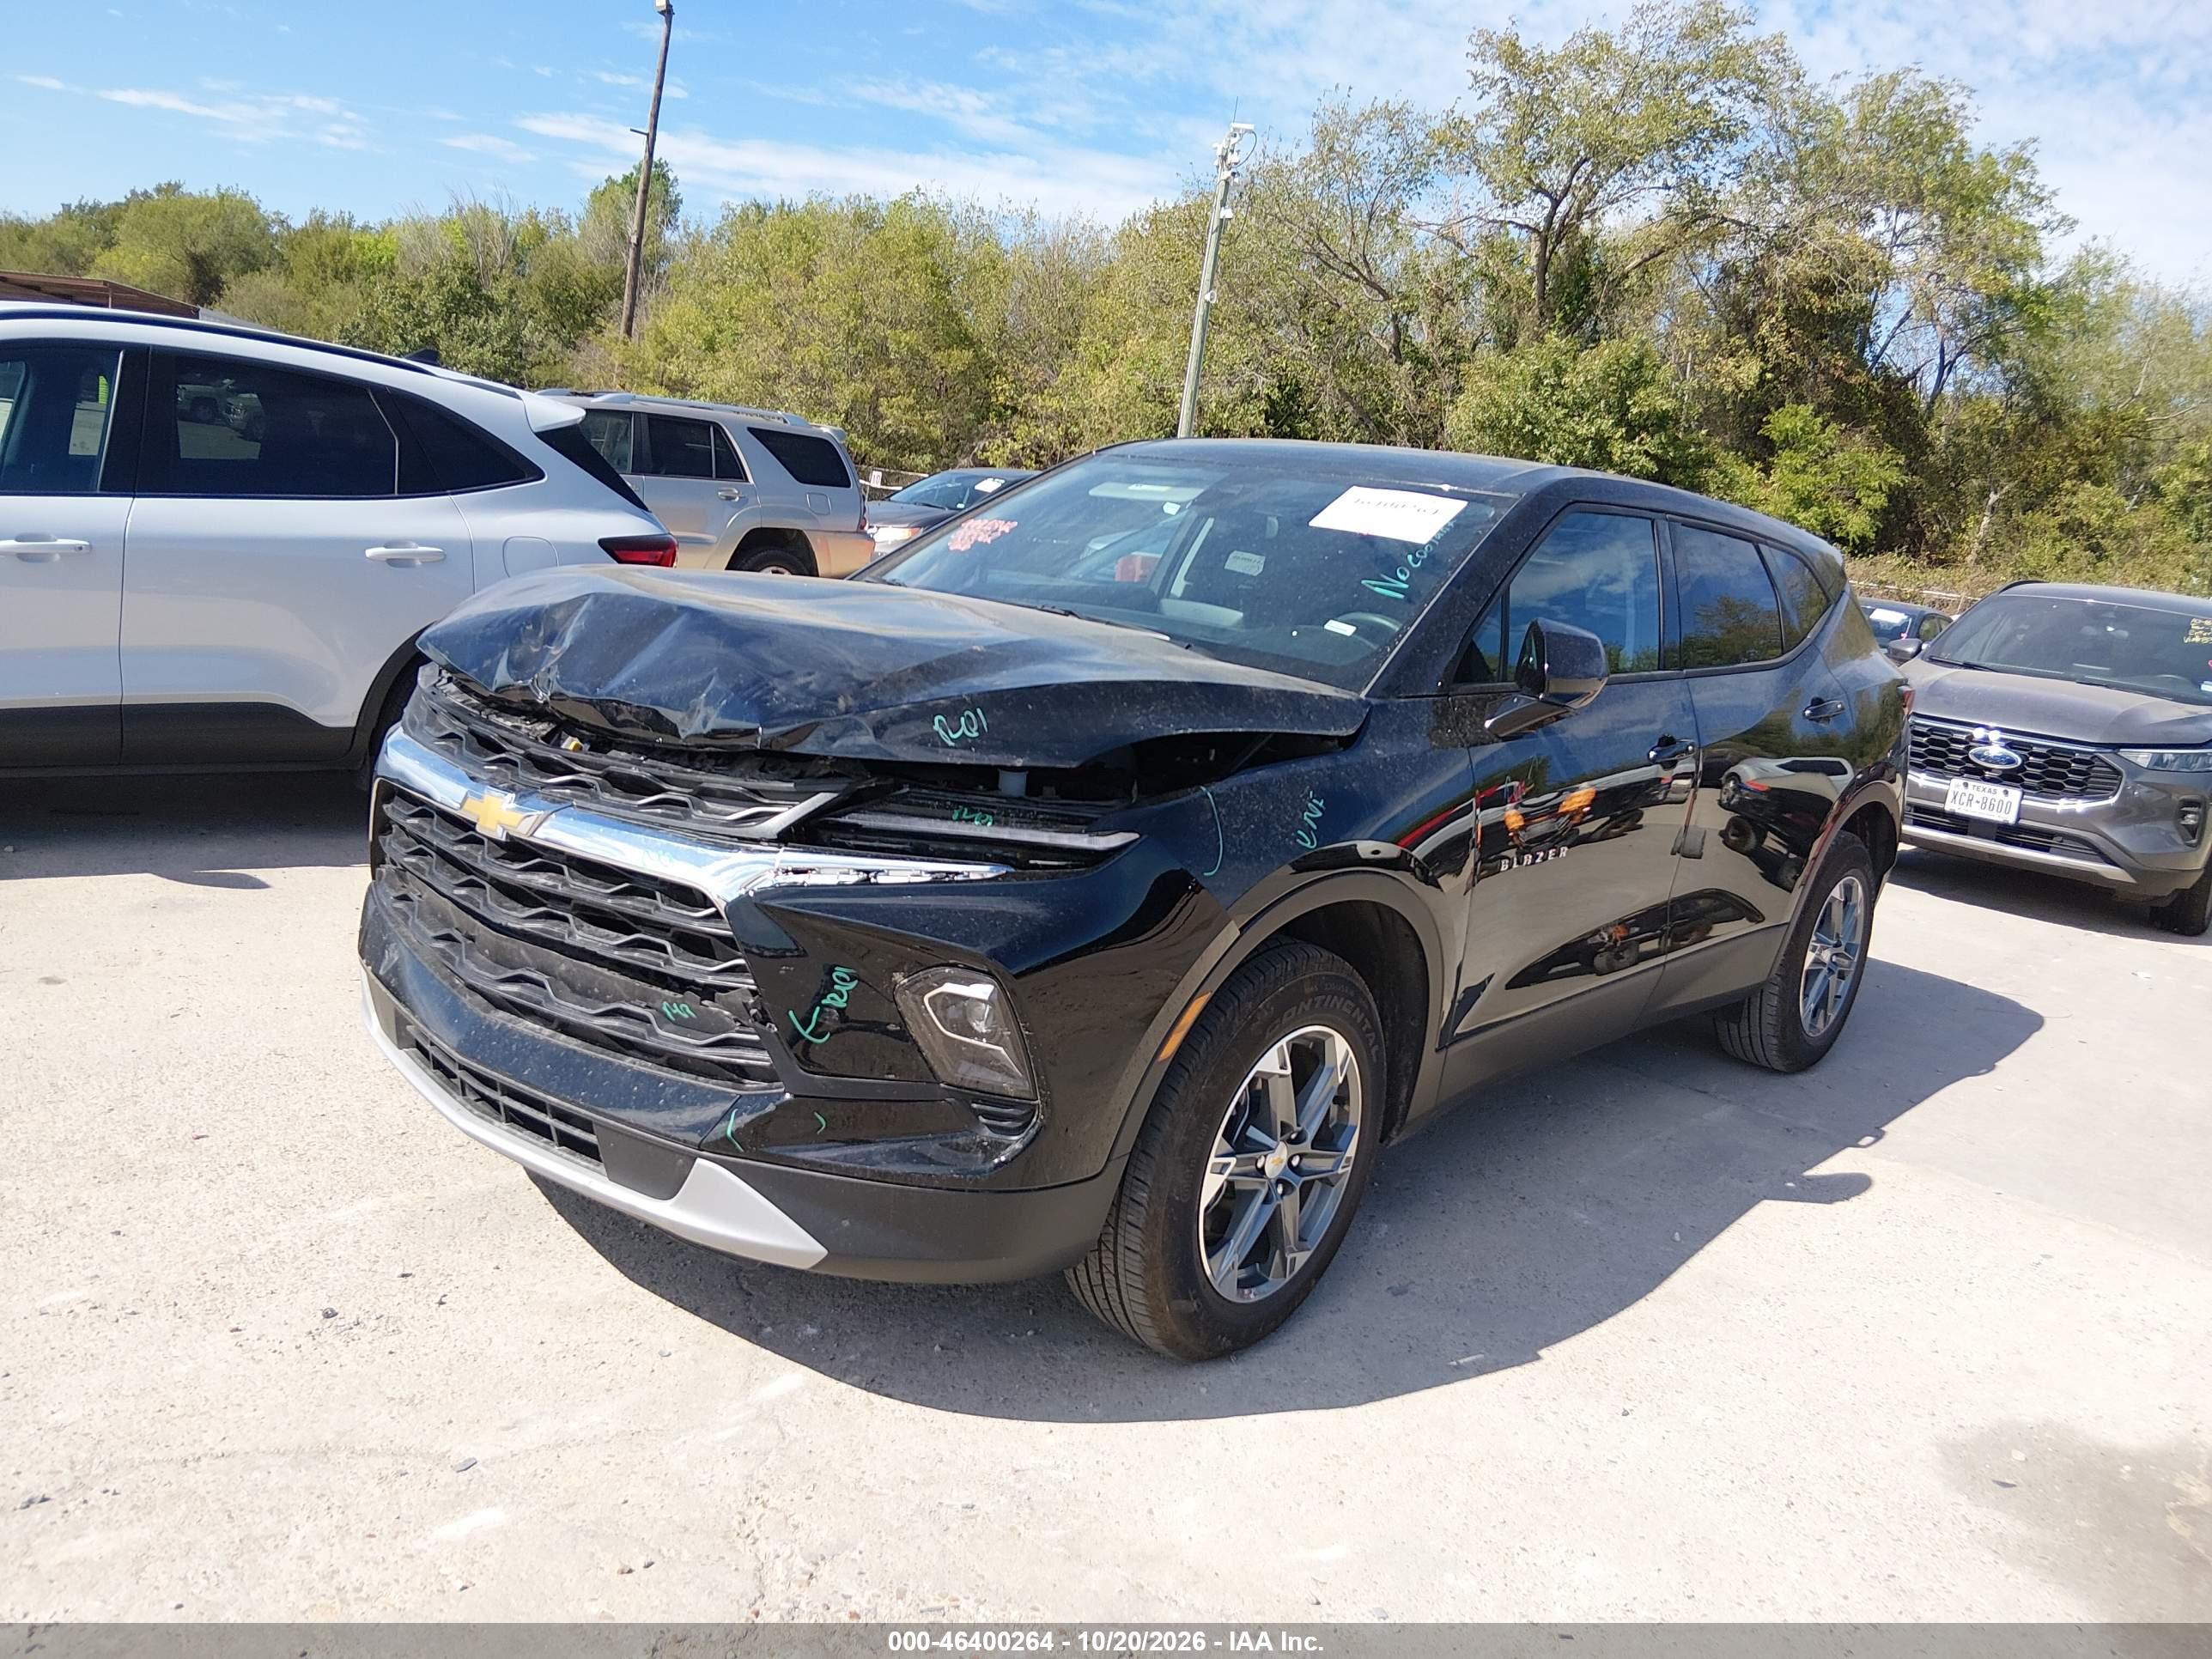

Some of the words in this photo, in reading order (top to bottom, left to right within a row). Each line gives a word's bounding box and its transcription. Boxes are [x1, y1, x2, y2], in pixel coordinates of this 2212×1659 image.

[1361, 566, 1410, 599] No
[1972, 784, 1998, 796] TEXAS
[1500, 846, 1569, 872] BLAZER
